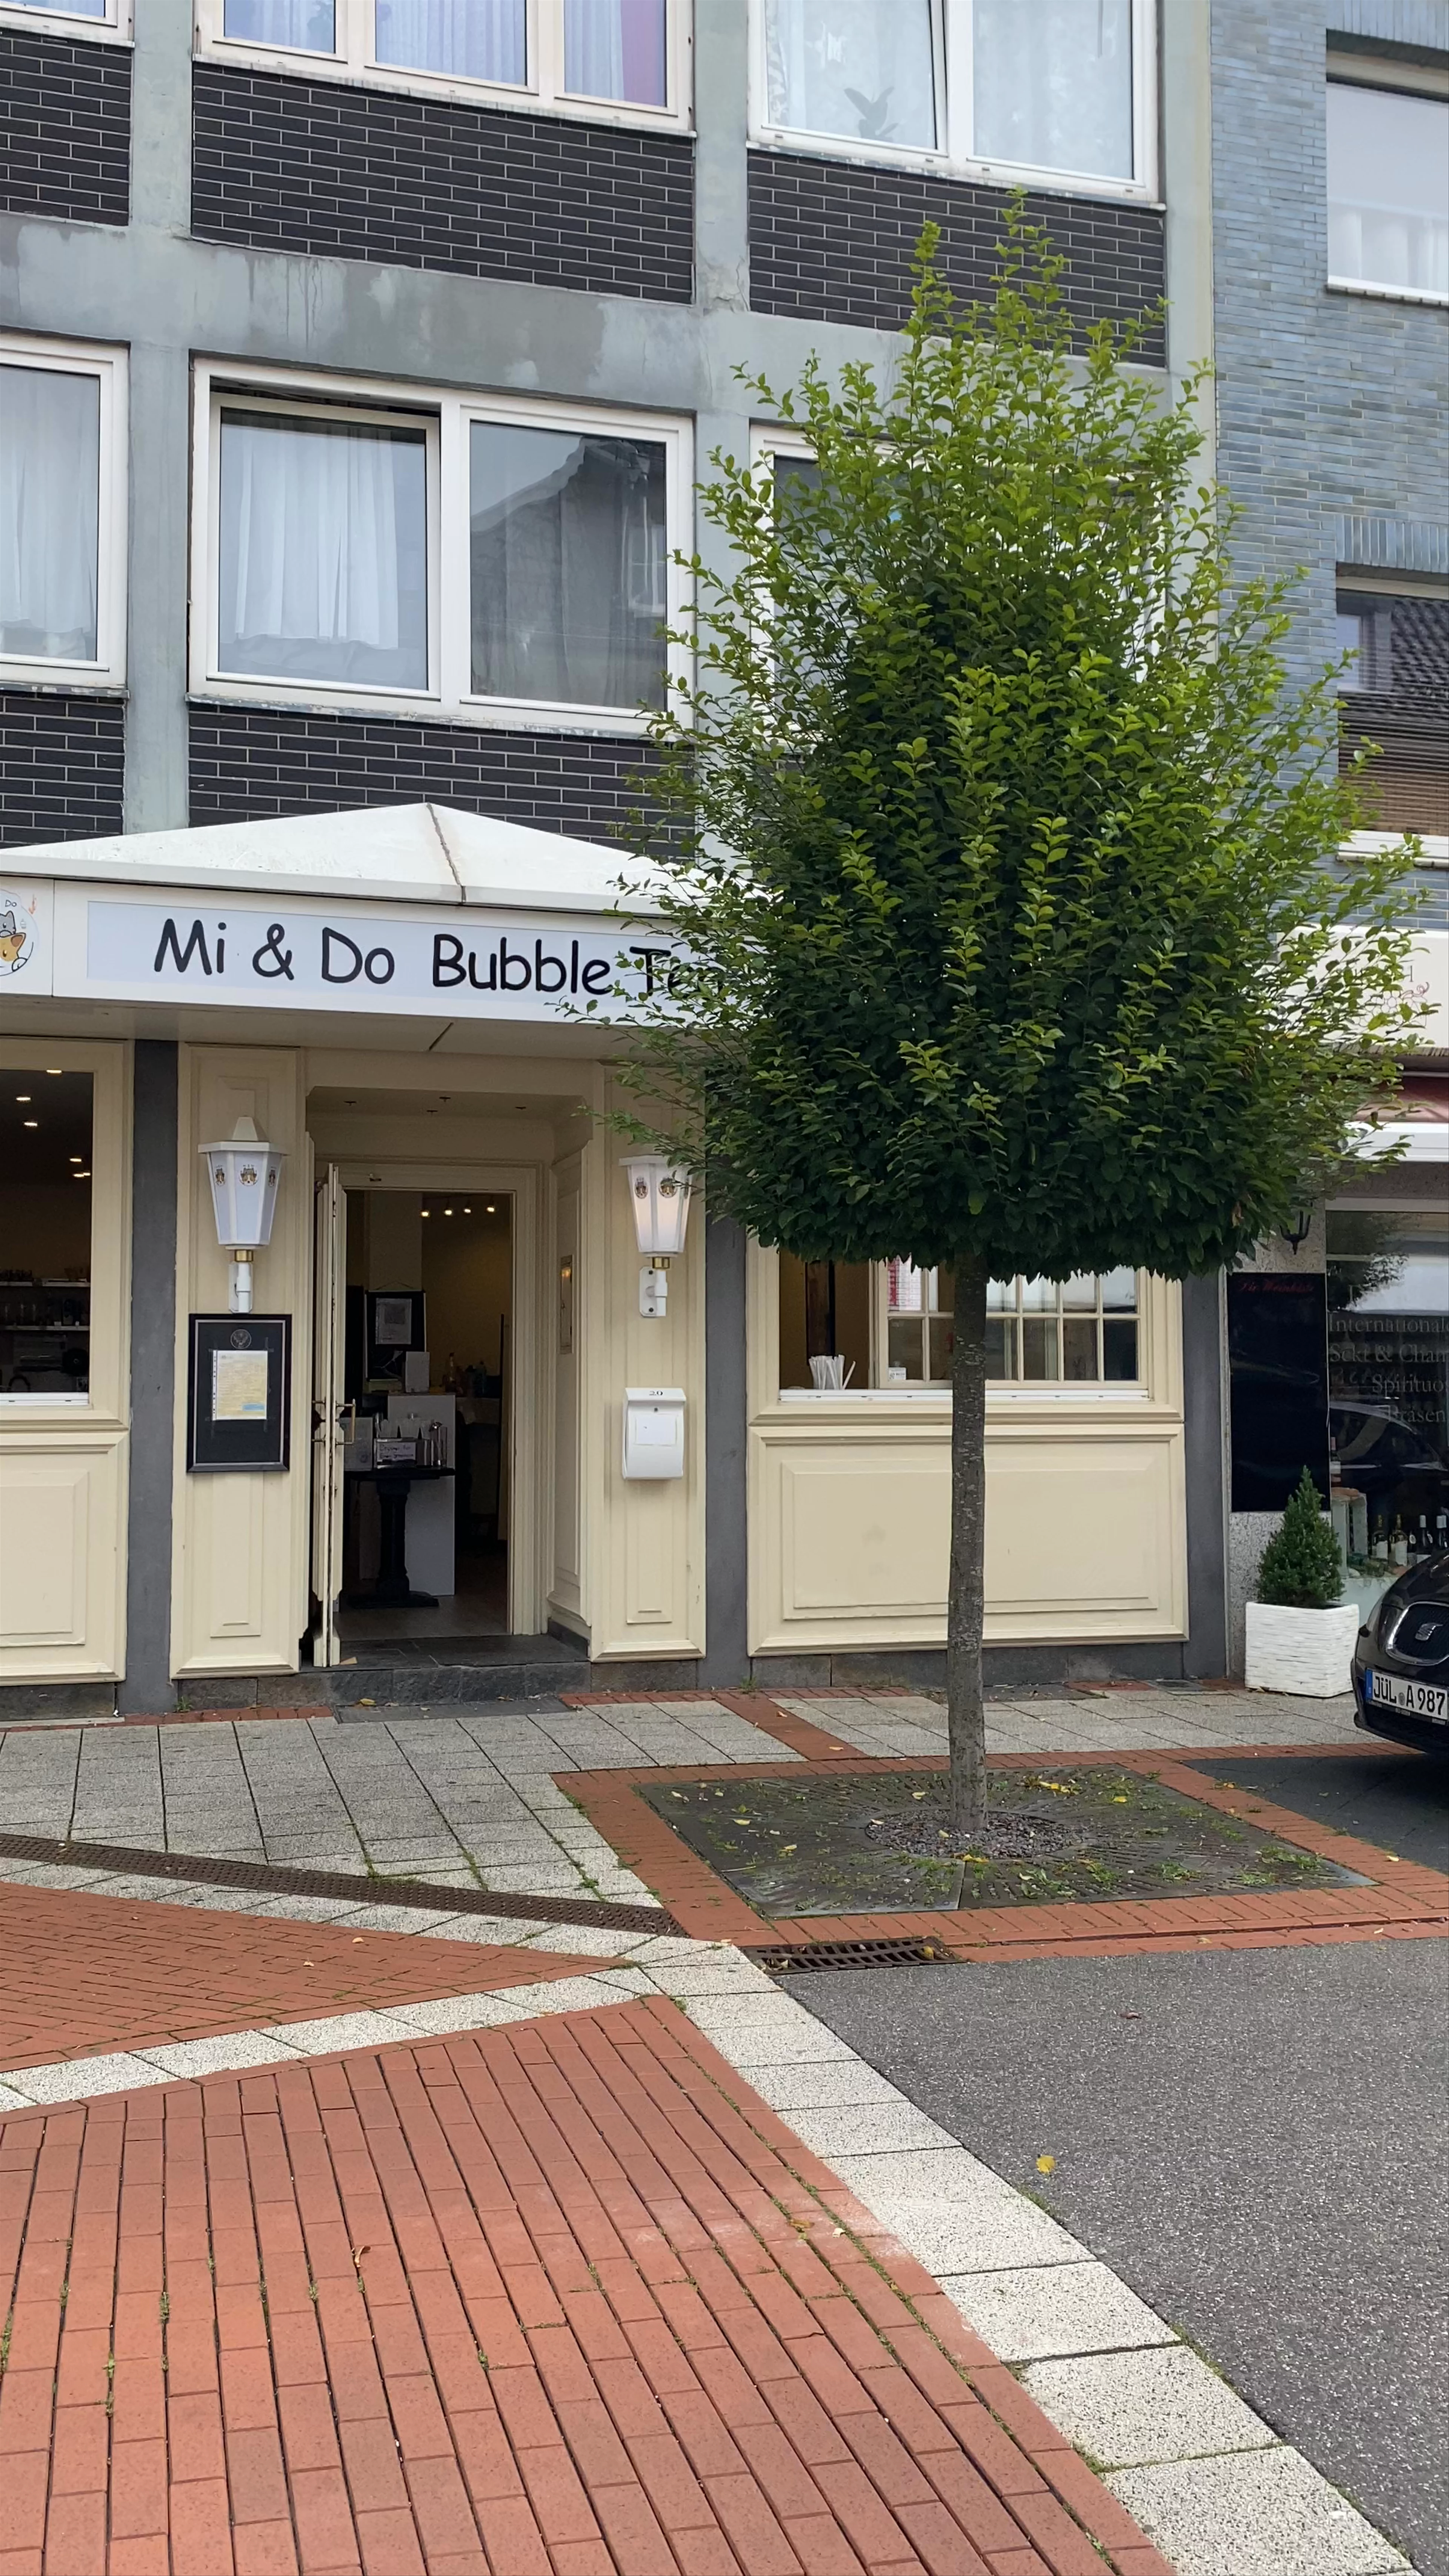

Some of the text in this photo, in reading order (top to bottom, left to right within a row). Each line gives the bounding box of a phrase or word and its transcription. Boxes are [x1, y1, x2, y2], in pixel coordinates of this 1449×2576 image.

[154, 918, 226, 975] Mi
[252, 923, 294, 980] &
[321, 927, 395, 984] Do
[433, 934, 613, 995] Bubble
[1375, 1344, 1392, 1363] &
[1374, 1676, 1445, 1715] JÜL A 987
